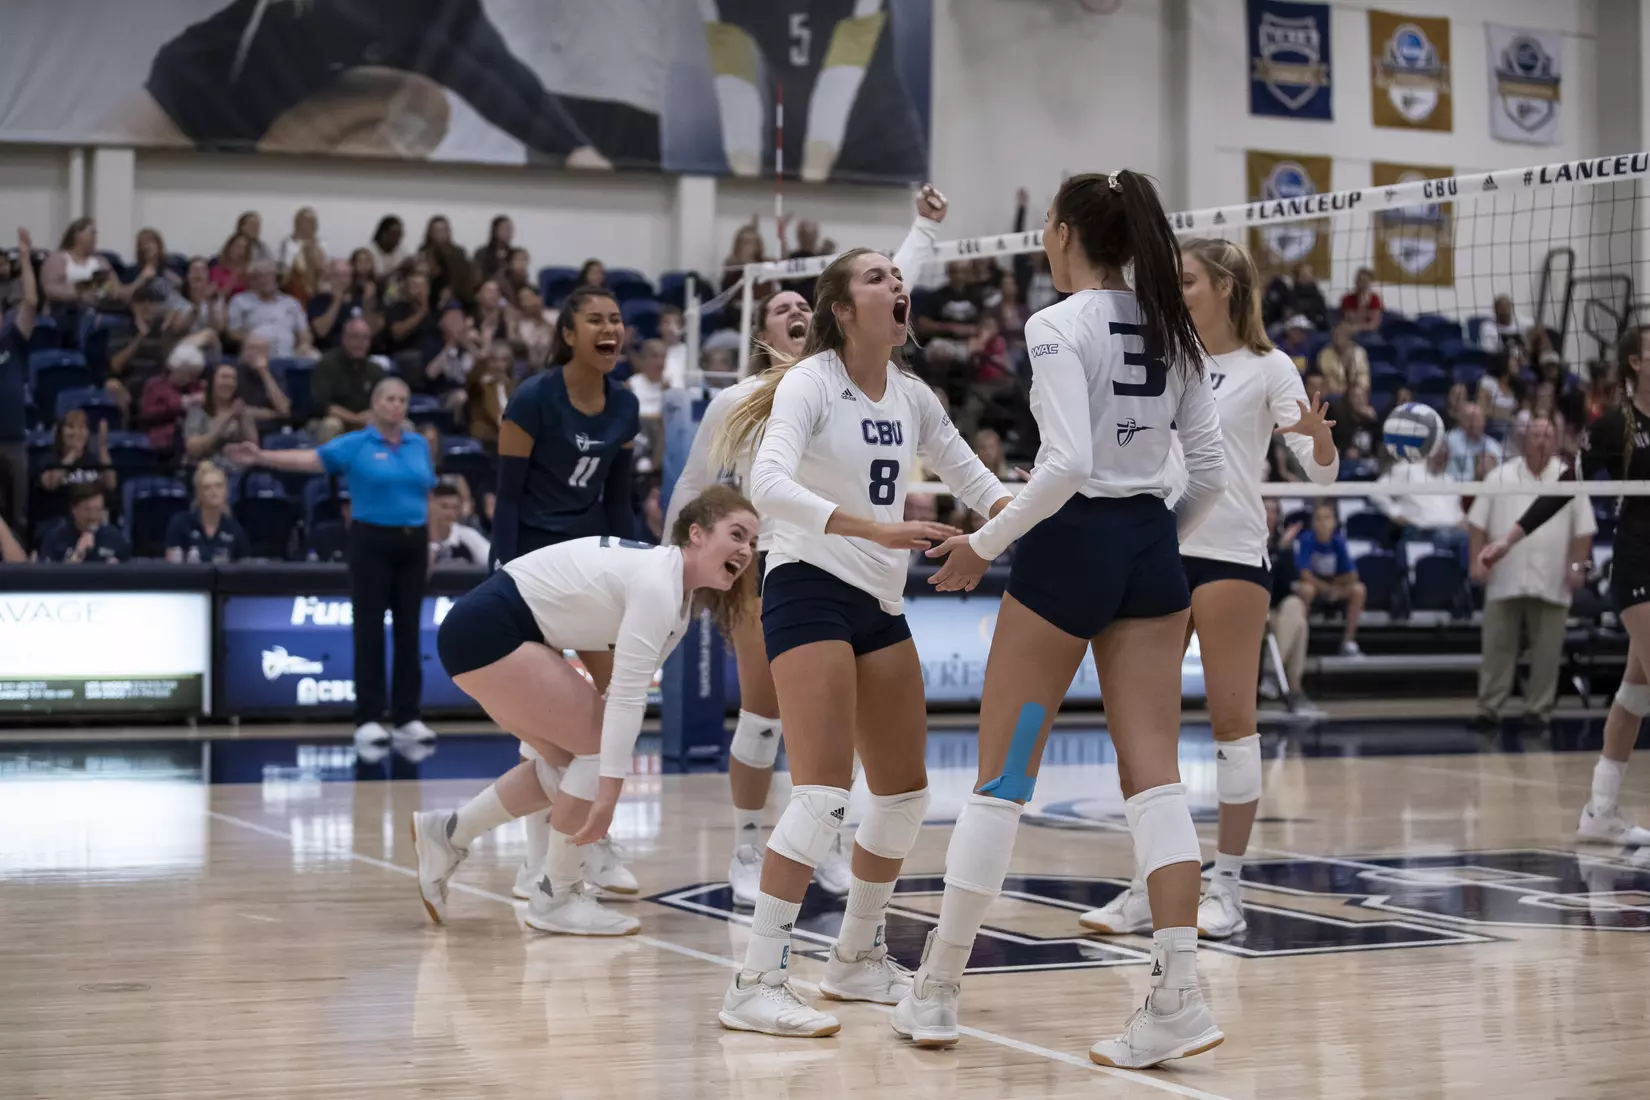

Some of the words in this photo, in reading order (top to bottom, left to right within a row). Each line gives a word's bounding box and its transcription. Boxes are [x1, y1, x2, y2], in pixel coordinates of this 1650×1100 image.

[788, 12, 812, 66] 5
[1246, 191, 1362, 221] #LANCEUP
[1423, 178, 1458, 199] CBU
[1031, 343, 1059, 359] WAC
[1108, 322, 1167, 397] 3
[862, 418, 903, 446] CBU
[568, 456, 601, 487] 11
[868, 459, 900, 505] 8
